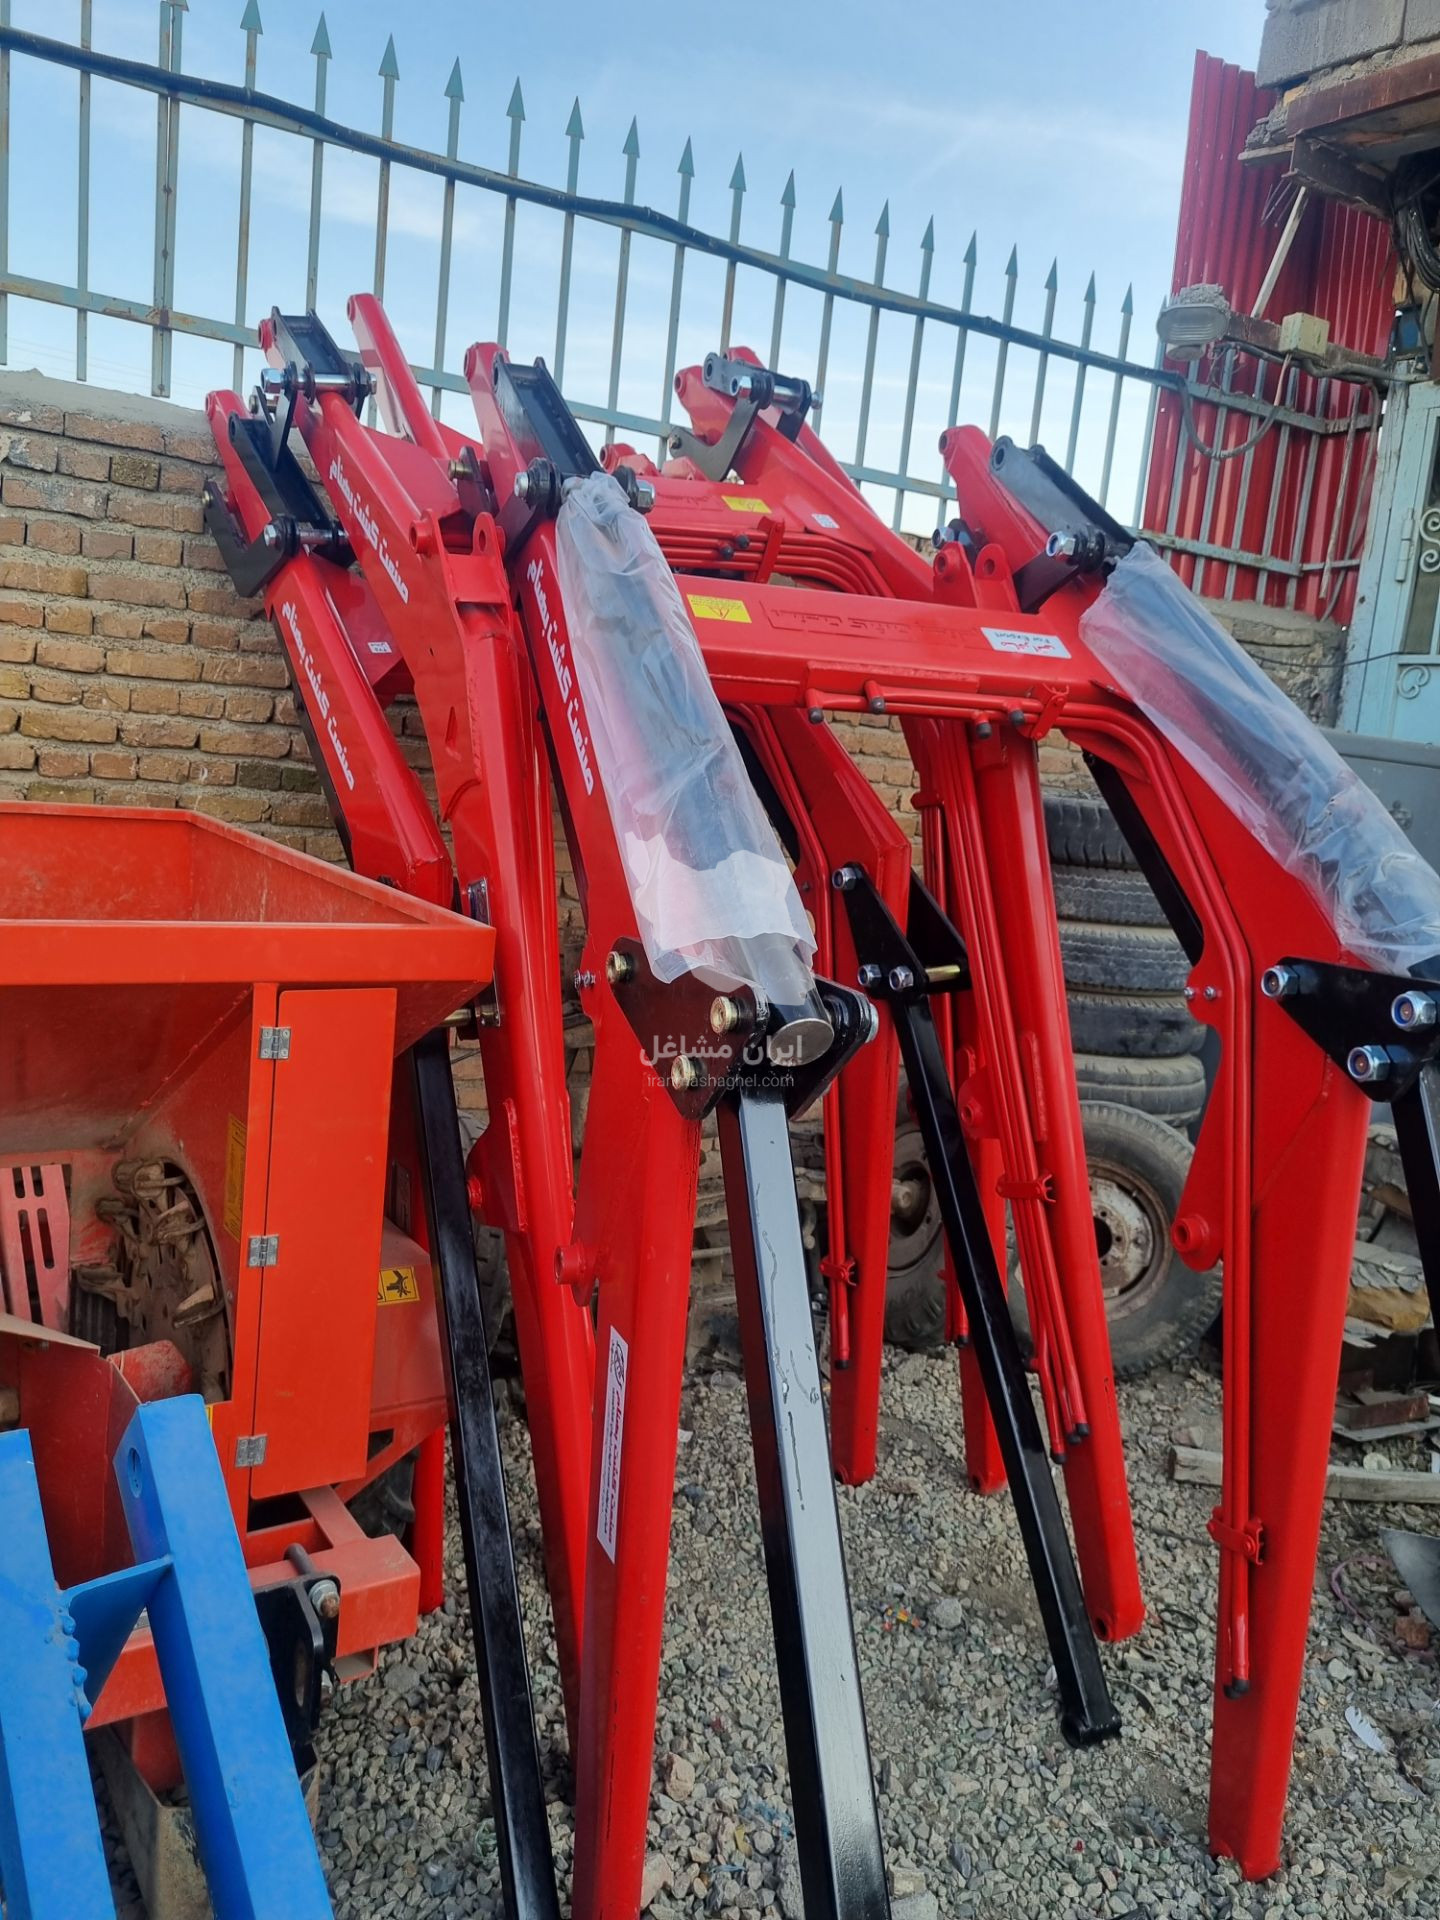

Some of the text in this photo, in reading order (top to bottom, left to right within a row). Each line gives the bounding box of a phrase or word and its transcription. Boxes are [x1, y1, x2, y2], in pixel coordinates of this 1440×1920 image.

[329, 455, 409, 604] صنعت کشت بهنام
[282, 601, 355, 791] صنعت کشت بهنام
[527, 559, 594, 796] صنعت کشت بهنام
